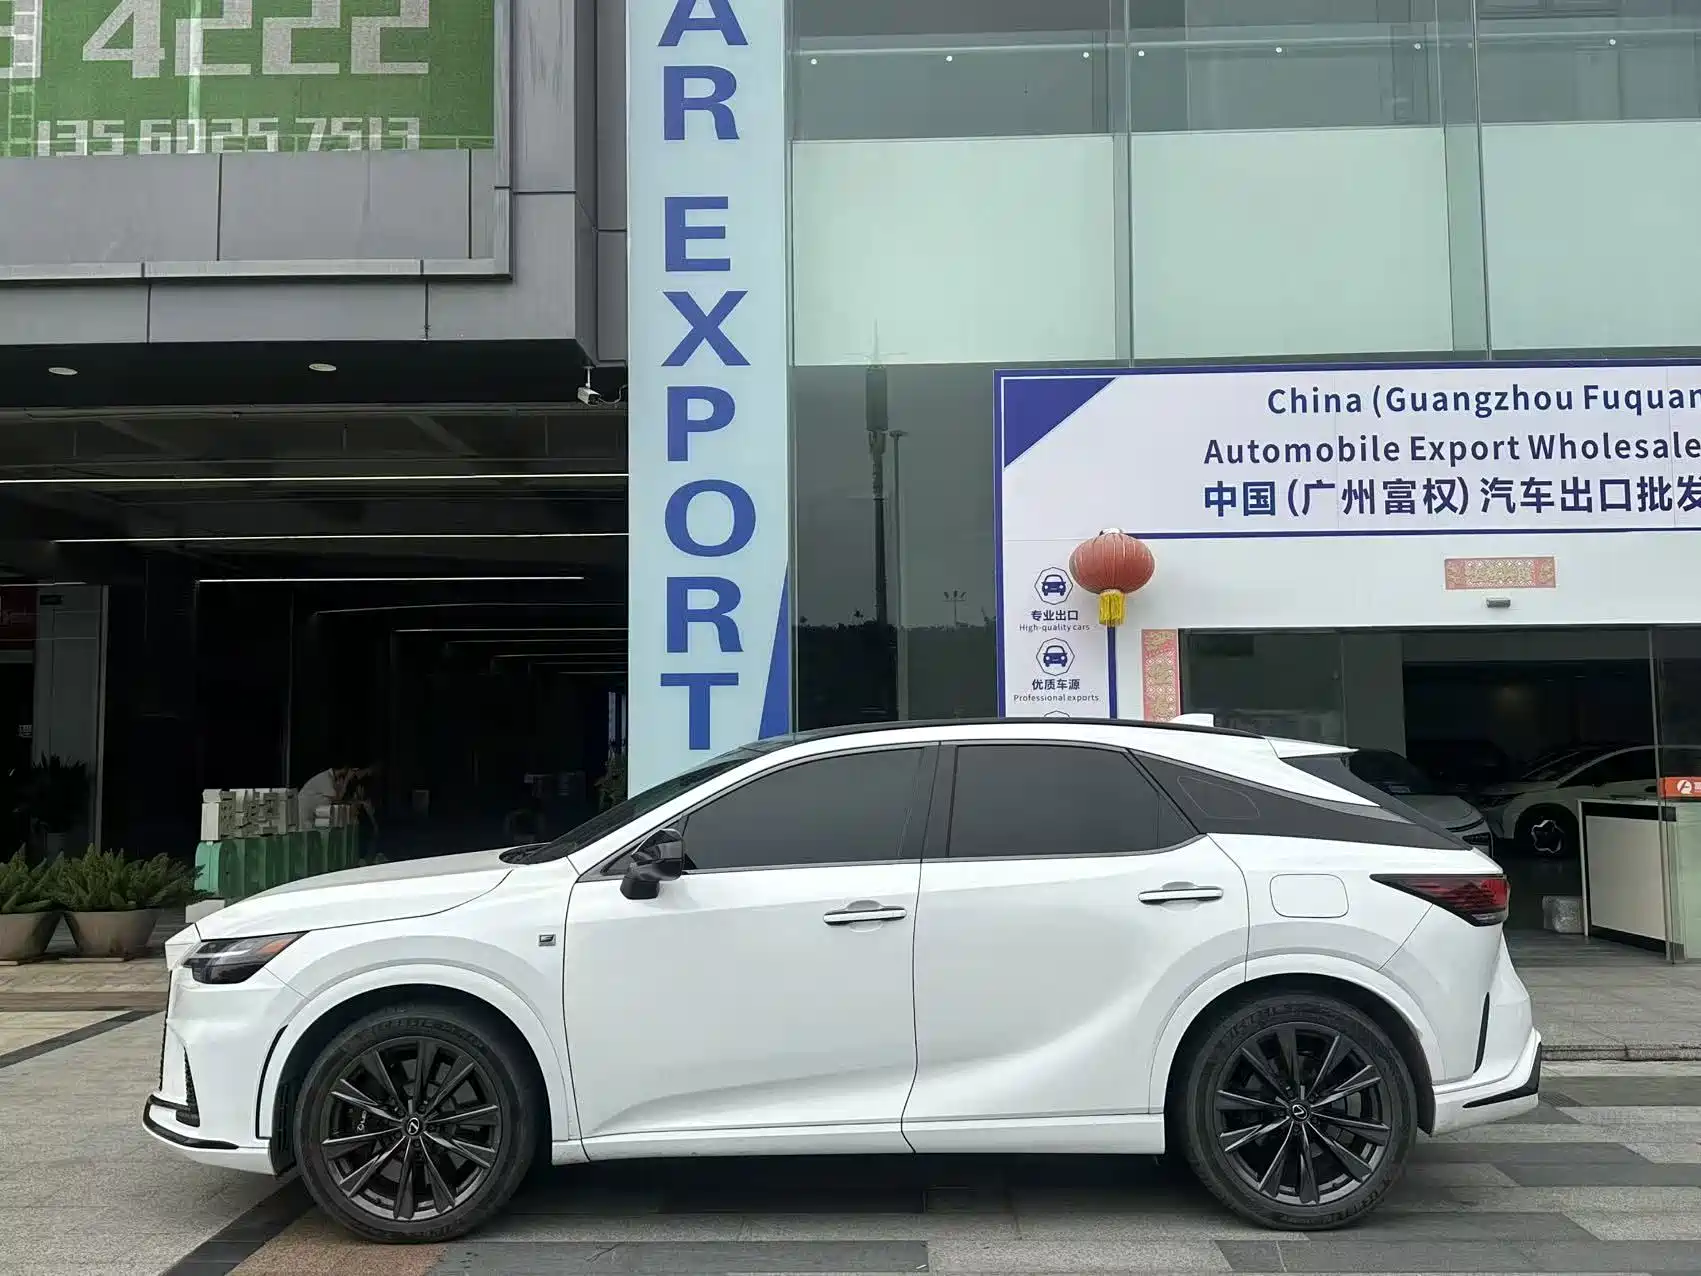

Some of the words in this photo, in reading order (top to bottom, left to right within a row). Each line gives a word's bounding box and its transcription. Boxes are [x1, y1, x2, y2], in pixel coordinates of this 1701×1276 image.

[37, 119, 125, 156] 135
[139, 117, 279, 154] 6025
[295, 117, 420, 152] 7513
[1268, 386, 1362, 414] China
[1373, 384, 1574, 418] (Guangzhou
[1583, 384, 1701, 416] Fuquan
[1203, 435, 1400, 464] Automobile
[1410, 435, 1520, 467] Export
[1528, 432, 1701, 459] Wholesale
[660, 196, 756, 750] EXPORT
[1031, 609, 1079, 621] 专业出口
[1019, 623, 1071, 632] High-quality
[1032, 678, 1081, 690] 优质车源
[1013, 693, 1066, 702] Professional
[1067, 694, 1100, 702] exports
